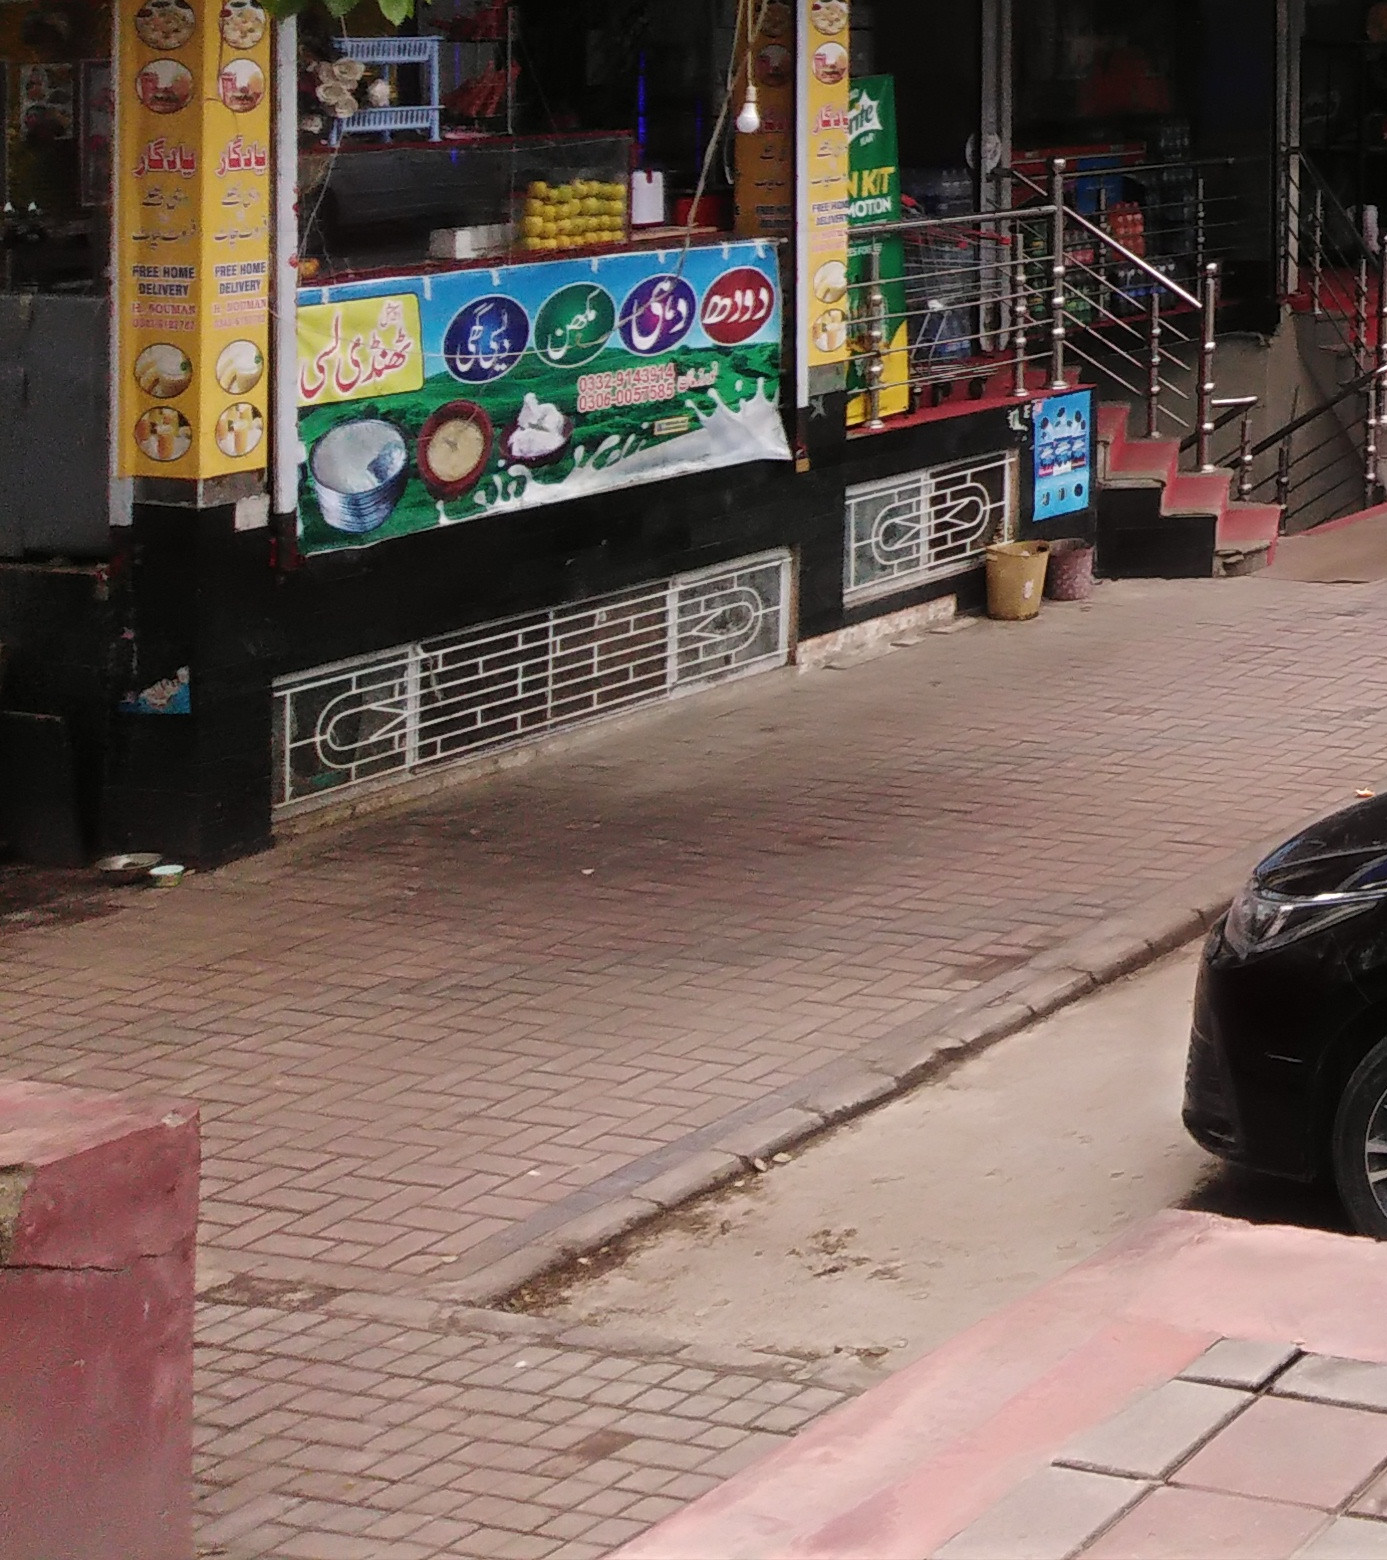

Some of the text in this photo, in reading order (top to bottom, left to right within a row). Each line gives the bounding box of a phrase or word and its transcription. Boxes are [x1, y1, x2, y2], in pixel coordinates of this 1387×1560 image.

[132, 138, 195, 179] یادگار
[215, 136, 267, 177] یادگار
[861, 166, 895, 198] KIT
[132, 265, 195, 279] FREE HOME
[214, 261, 266, 278] FREE HOME
[138, 283, 189, 297] DELIVERY
[219, 279, 261, 295] DELIVERY
[701, 287, 770, 326] دودھ
[299, 313, 413, 400] ٹھنڈی لسی
[577, 383, 676, 413] 0306-0057585
